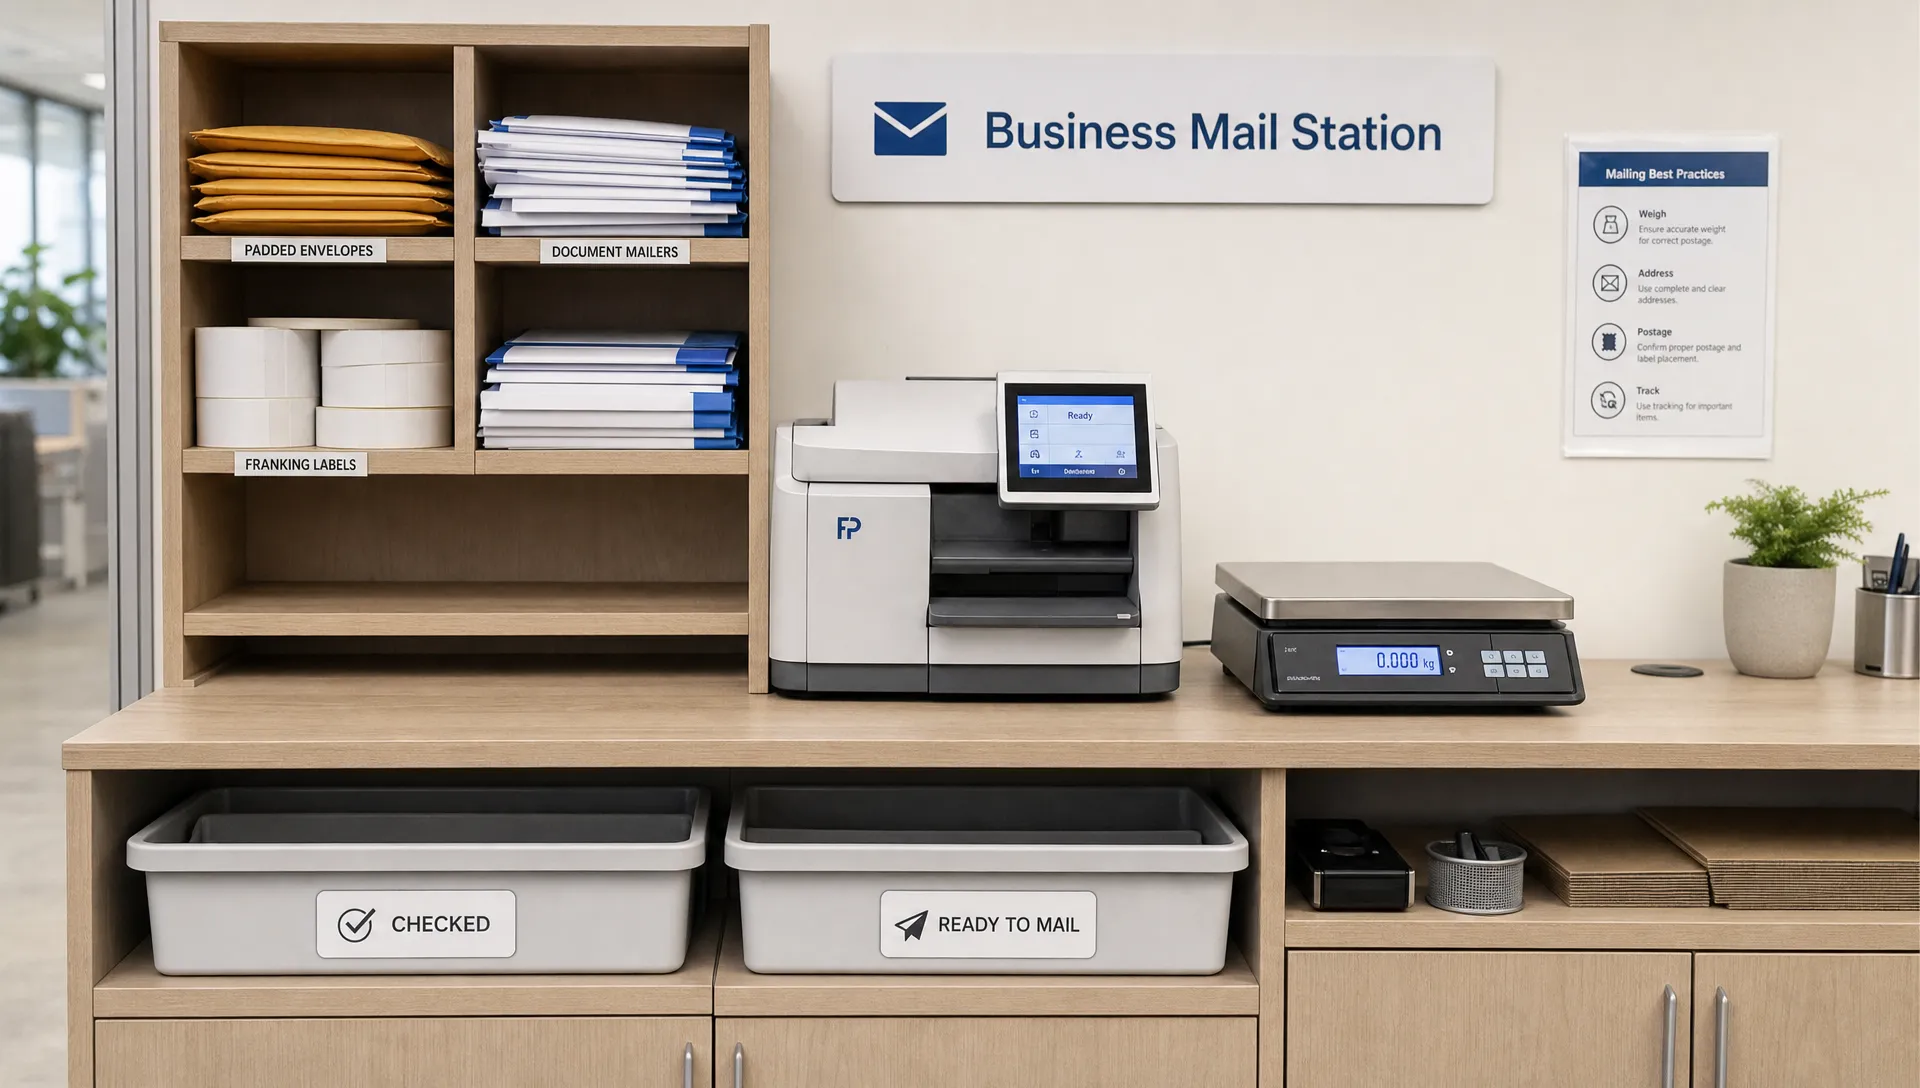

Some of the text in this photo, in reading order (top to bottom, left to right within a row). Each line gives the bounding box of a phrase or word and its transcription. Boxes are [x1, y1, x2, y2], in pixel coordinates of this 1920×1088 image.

[985, 111, 1442, 152] Business Mail Station
[1606, 169, 1725, 181] Mailing Best Practices
[1639, 209, 1666, 219] Weigh
[1639, 225, 1726, 235] Ensure accurate weight
[1639, 236, 1713, 247] for correct postage.
[244, 244, 373, 256] PADDED ENVELOPES
[552, 246, 678, 258] DOCUMENT MAILERS
[1638, 269, 1673, 277] Address
[1638, 285, 1726, 295] Use complete and clear
[1638, 296, 1677, 304] addresses.
[1637, 327, 1672, 337] Postage
[1637, 343, 1741, 354] Confirm proper postage and
[1637, 355, 1699, 365] label placement.
[1637, 387, 1660, 395] Track
[1637, 402, 1732, 413] Use tracking for important
[1068, 412, 1093, 421] Ready
[1636, 414, 1658, 422] items.
[245, 458, 356, 471] FRANKING LABELS
[837, 516, 861, 539] FP
[1377, 652, 1434, 670] 0.000 kg
[392, 915, 490, 933] CHECKED
[939, 916, 1080, 933] READY TO MAIL
